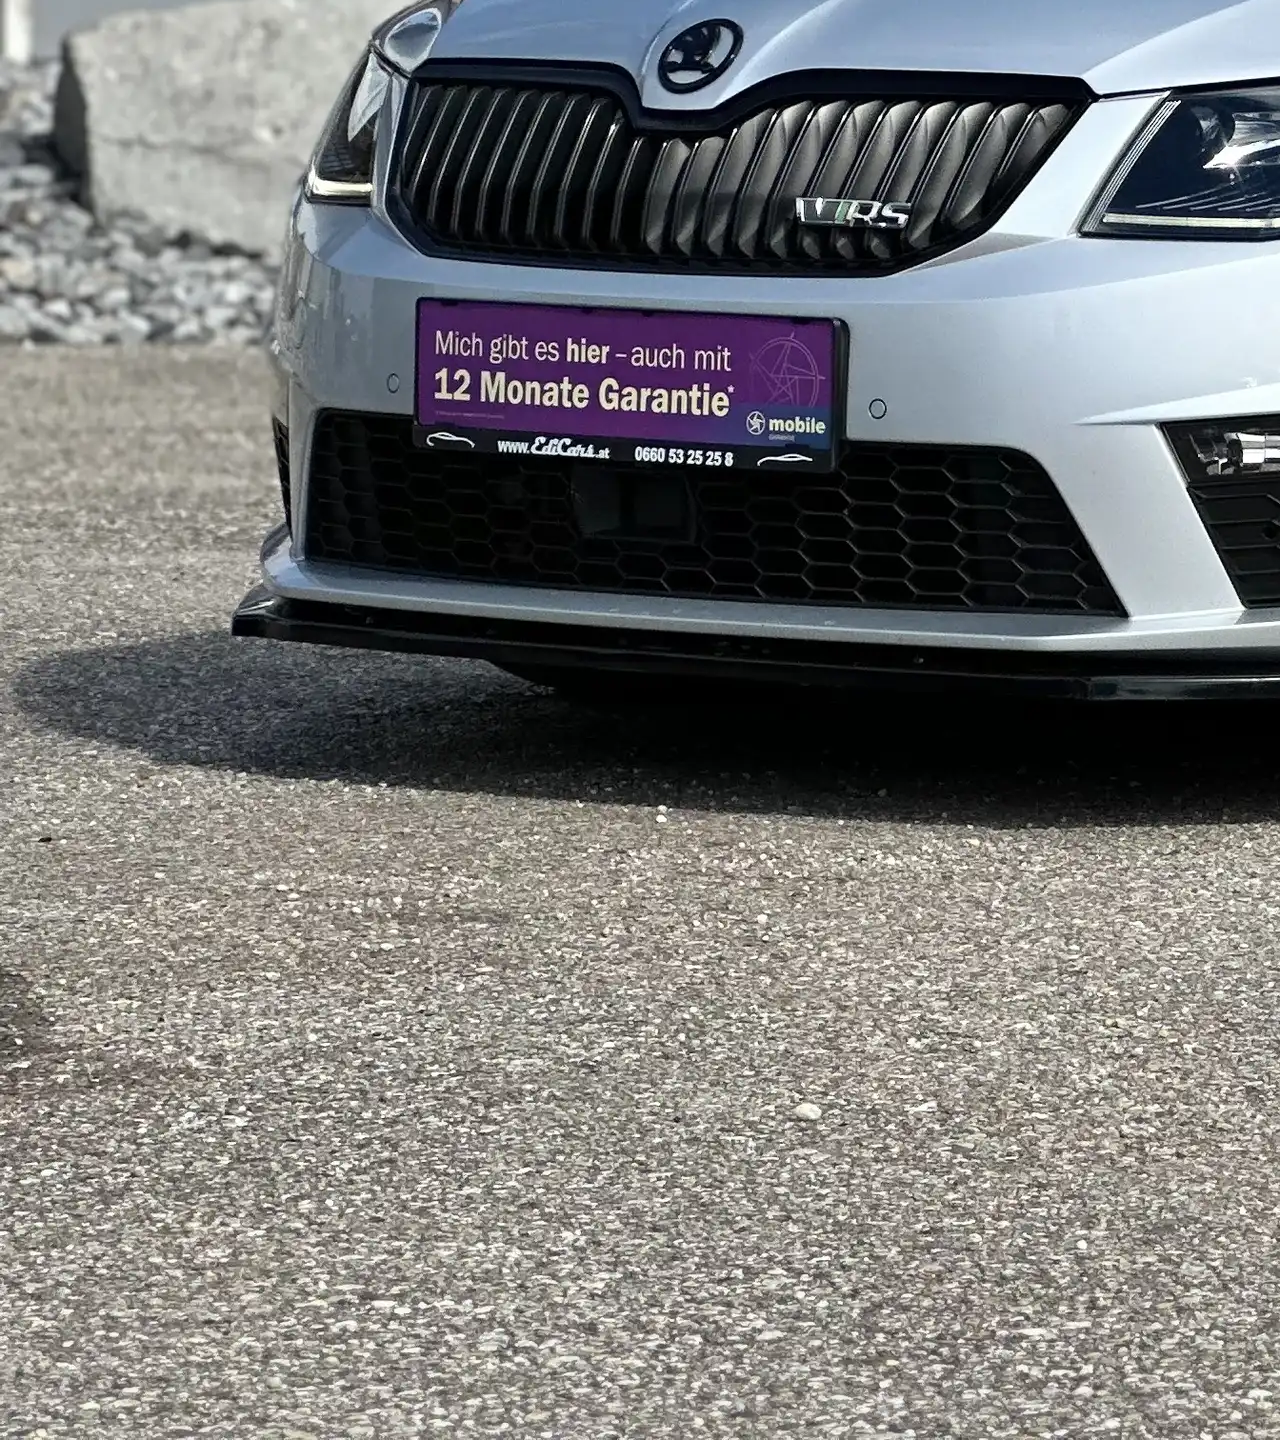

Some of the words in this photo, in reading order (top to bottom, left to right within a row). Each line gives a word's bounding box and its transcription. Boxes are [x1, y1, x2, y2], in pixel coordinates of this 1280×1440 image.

[435, 330, 483, 357] Mich
[489, 334, 529, 364] gibt
[535, 341, 560, 362] es
[566, 337, 610, 364] hier
[631, 343, 685, 369] auch
[694, 345, 732, 371] mit
[434, 367, 471, 400] 12
[480, 370, 590, 409] Monate
[768, 416, 826, 434] mobile
[634, 446, 665, 463] 0660
[668, 448, 684, 464] 53
[686, 449, 703, 465] 25
[705, 451, 721, 466] 25
[724, 452, 734, 467] 8
